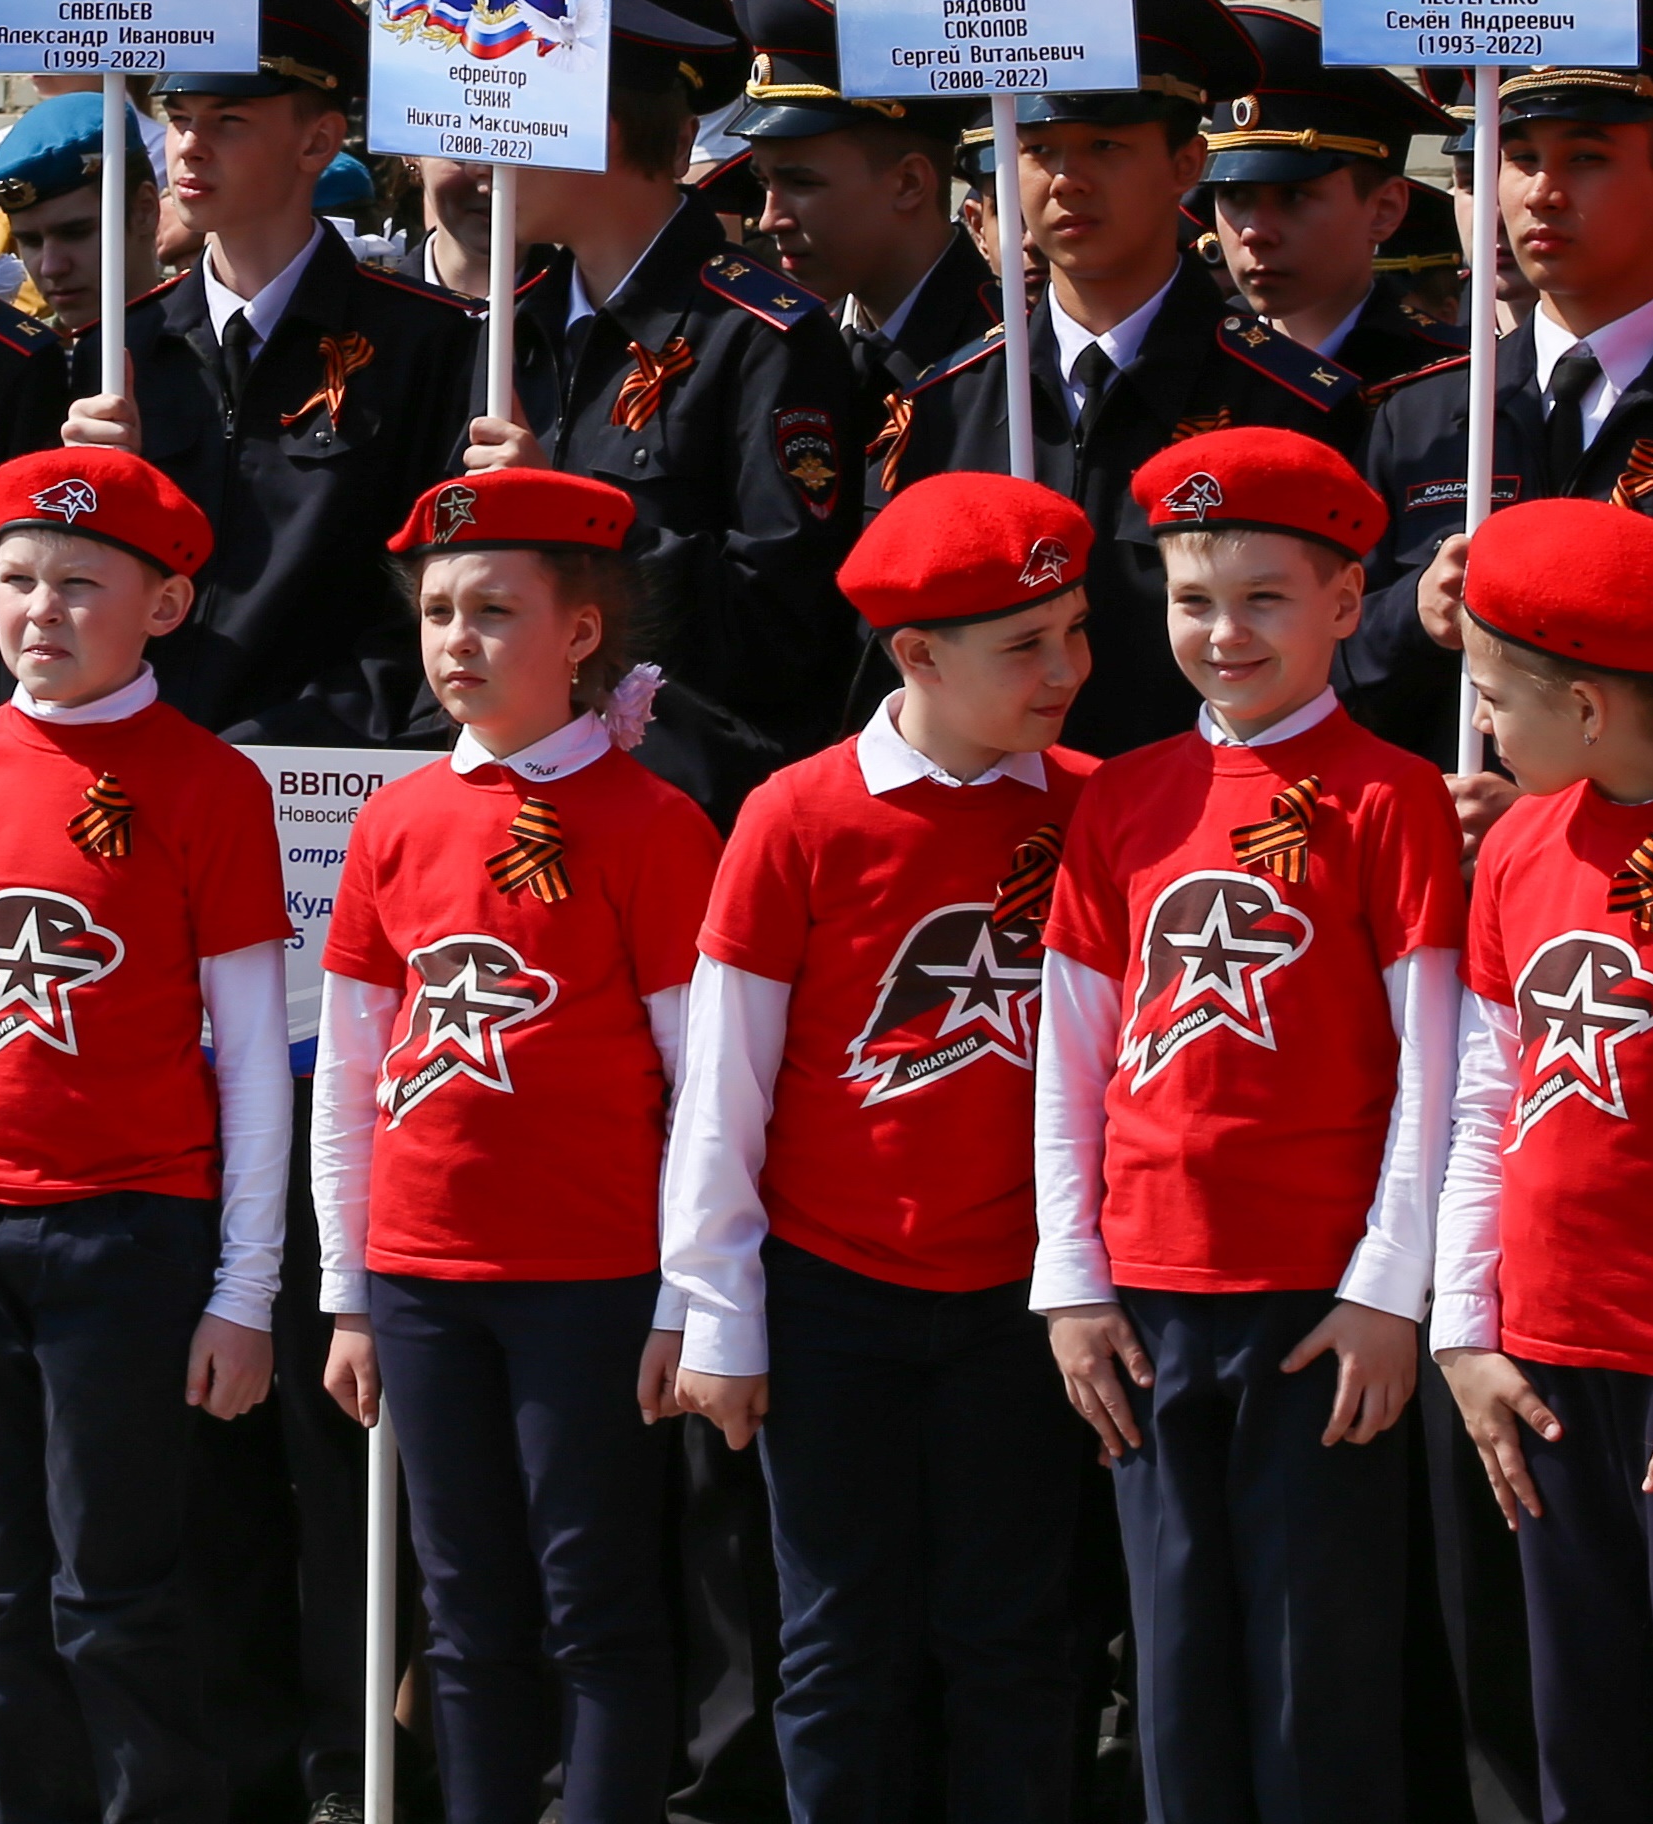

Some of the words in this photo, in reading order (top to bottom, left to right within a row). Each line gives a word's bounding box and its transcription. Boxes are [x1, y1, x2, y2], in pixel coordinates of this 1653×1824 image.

[58, 1, 153, 21] САВЕЛЬЕВ
[1386, 8, 1450, 30] Семён
[1460, 10, 1575, 33] Андреевич
[119, 26, 214, 45] Иванович
[944, 18, 1028, 40] СОКОЛОВ
[892, 46, 961, 68] Сергей
[970, 43, 1084, 64] Витальевич
[1418, 33, 1543, 56] (1993-2022)
[44, 49, 166, 70] (1999-2022)
[449, 64, 527, 89] ефрейтор
[930, 68, 1048, 91] (2000-2022)
[464, 87, 511, 109] СУХИХ
[407, 108, 462, 130] Никита
[469, 112, 569, 138] Максимович
[439, 135, 533, 161] (2000-2022)
[785, 437, 831, 457] РОССИЯ
[1154, 1006, 1210, 1056] ЮНАРМИЯ
[906, 1035, 979, 1081] ЮНАРМИЯ
